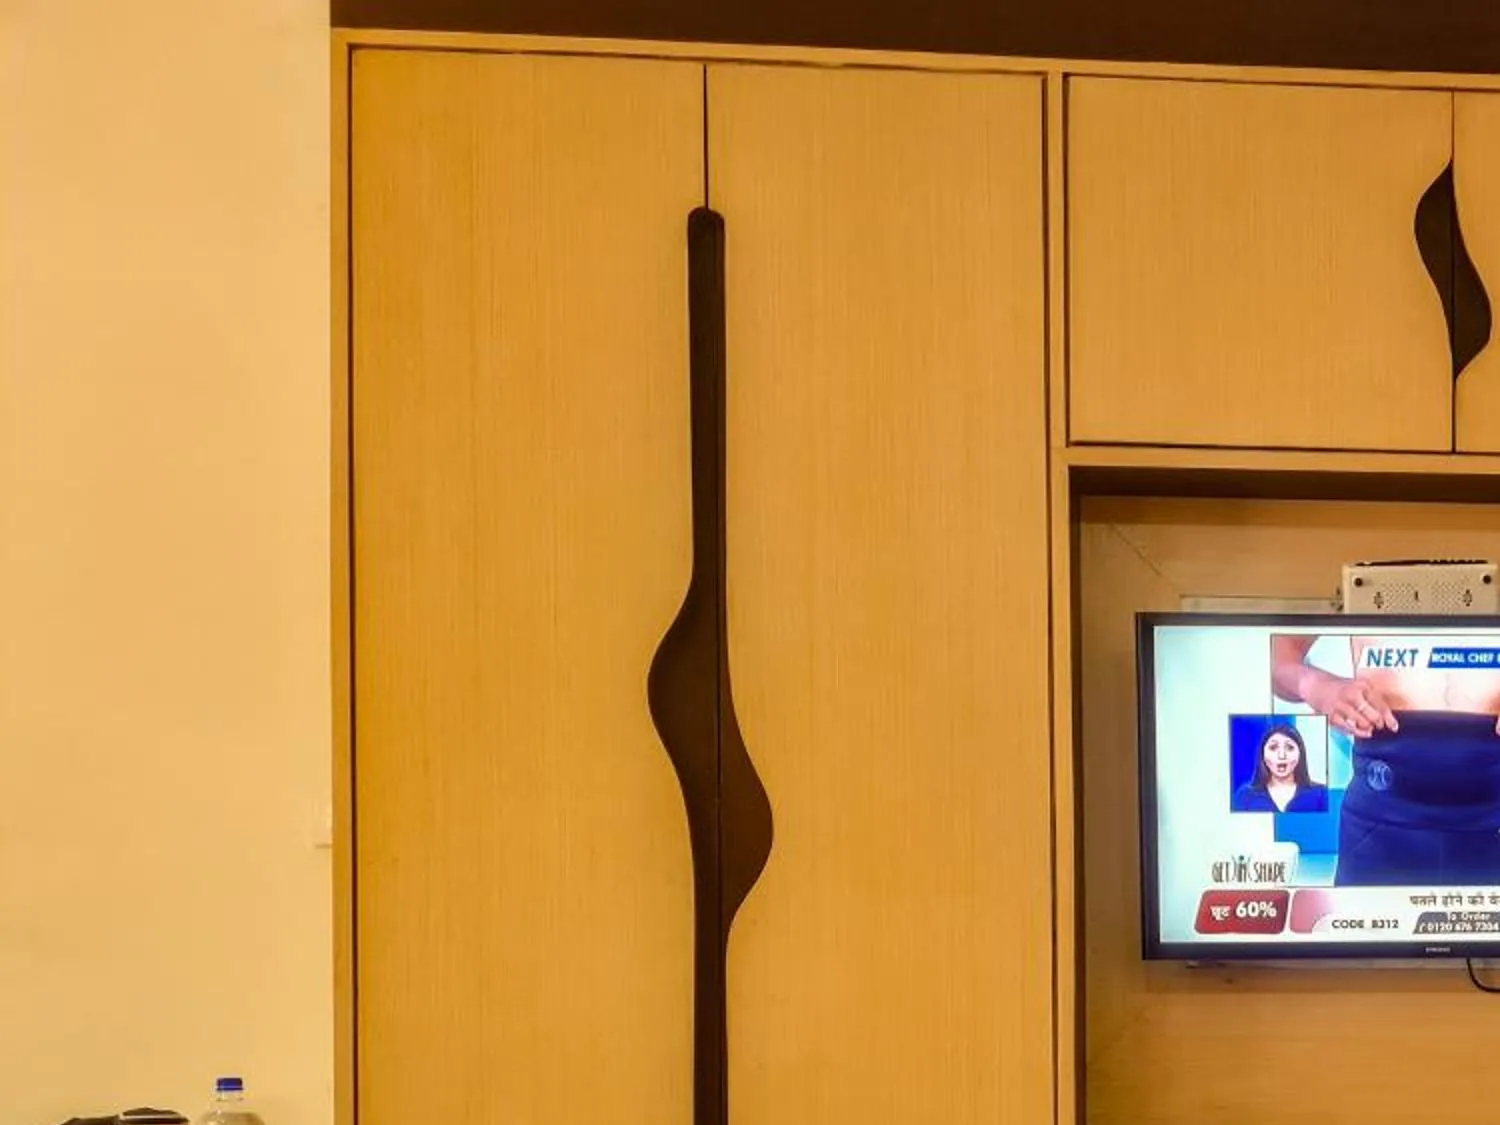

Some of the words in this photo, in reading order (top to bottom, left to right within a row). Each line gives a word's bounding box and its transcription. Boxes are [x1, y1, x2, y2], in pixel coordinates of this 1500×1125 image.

[1366, 648, 1418, 668] NEXT
[1253, 861, 1286, 883] SHAPE
[1235, 901, 1278, 918] 60%
[1331, 919, 1365, 929] CODE
